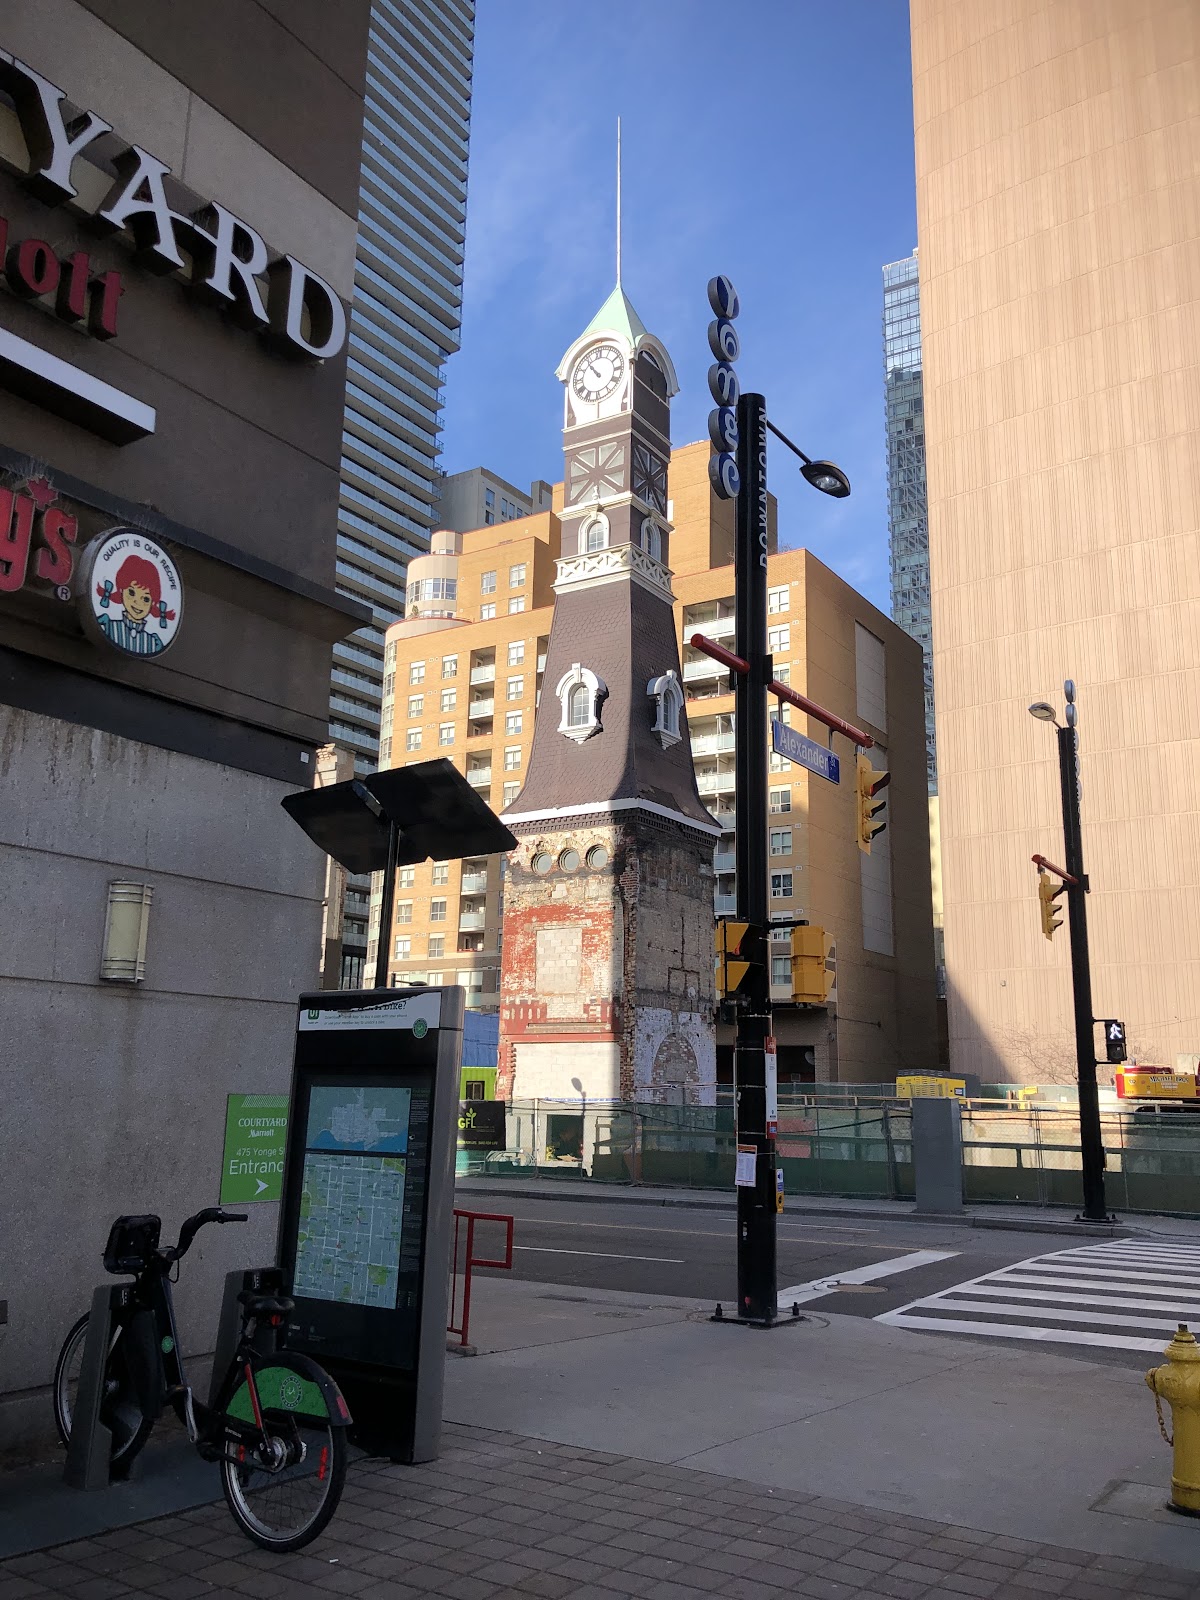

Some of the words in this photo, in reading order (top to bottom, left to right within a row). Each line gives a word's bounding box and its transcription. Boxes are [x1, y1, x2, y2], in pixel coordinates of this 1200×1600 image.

[0, 47, 346, 358] YARD
[102, 538, 130, 561] QUALITY
[133, 539, 141, 548] IS
[144, 543, 160, 559] OUR
[160, 558, 177, 591] RECIPE
[780, 727, 829, 771] Alexander
[238, 1117, 288, 1127] COURTYARD
[457, 1113, 477, 1129] GFL
[236, 1147, 251, 1157] 475
[253, 1147, 277, 1157] Yonge
